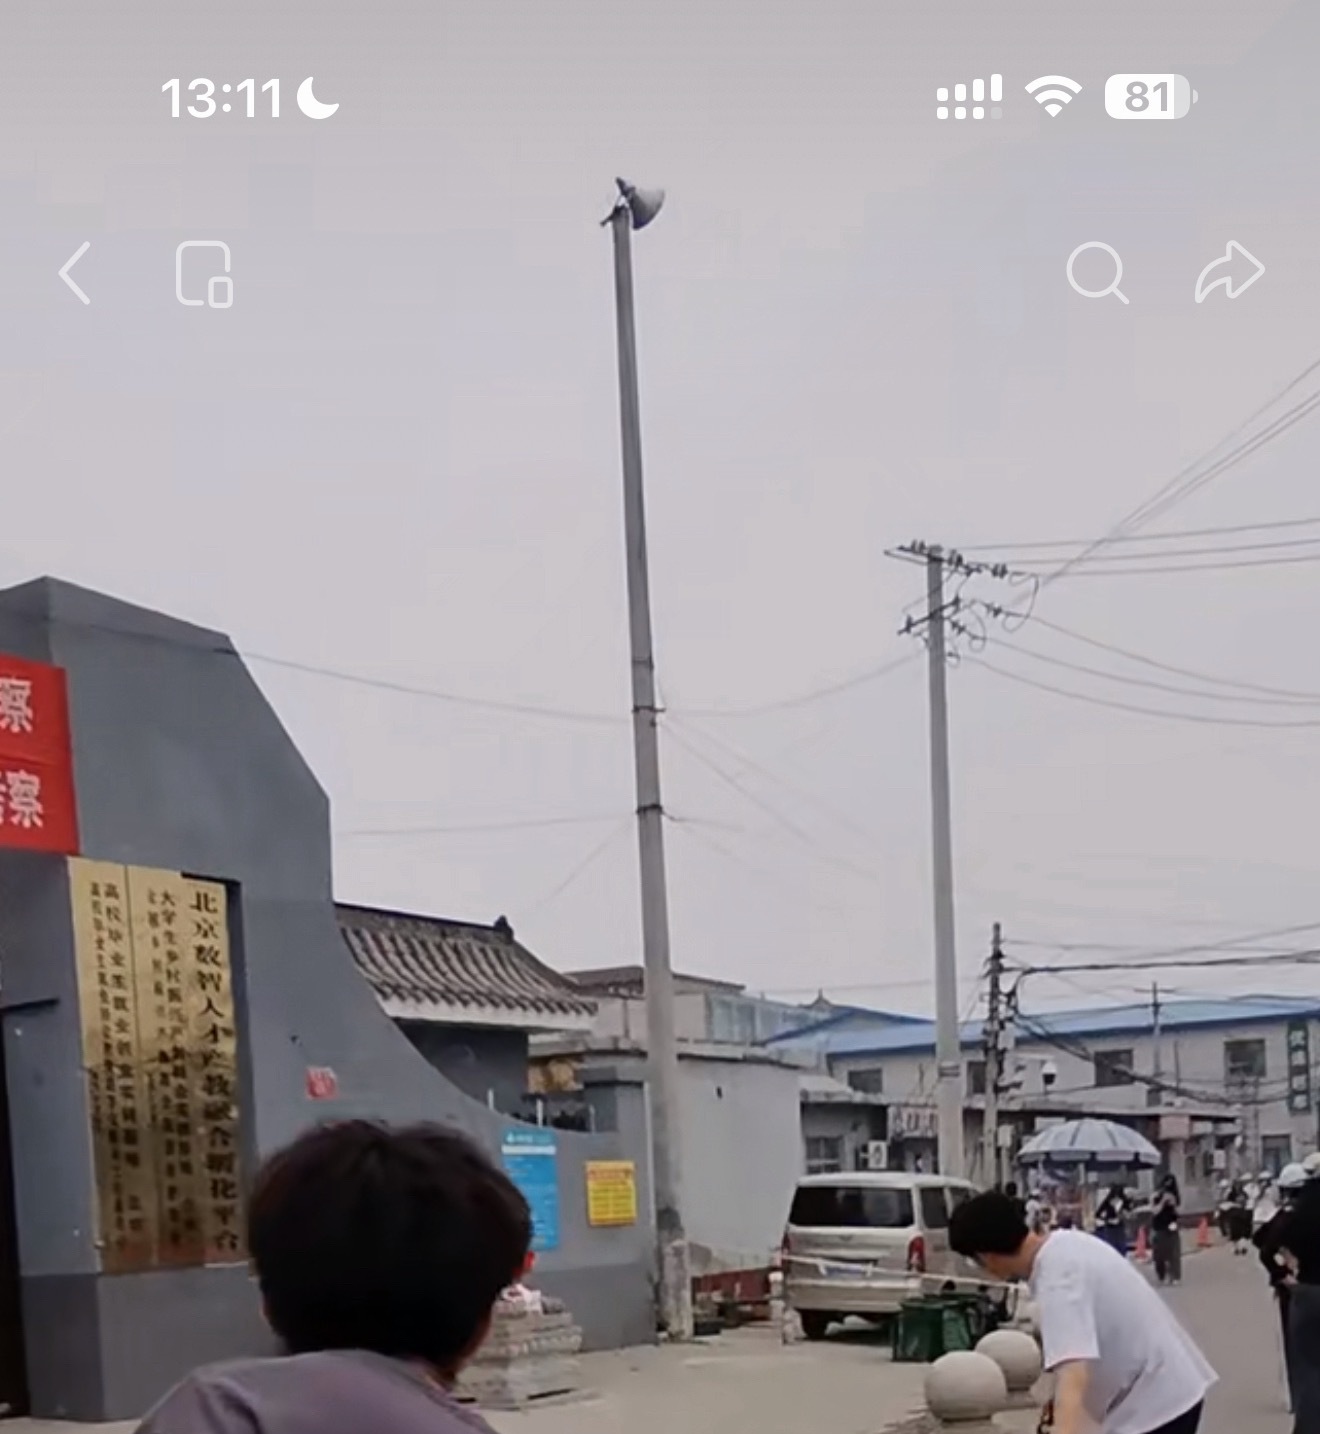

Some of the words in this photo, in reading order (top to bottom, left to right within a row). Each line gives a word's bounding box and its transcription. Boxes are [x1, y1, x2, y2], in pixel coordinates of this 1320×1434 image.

[189, 890, 238, 1250] 北京数智人才产教融合孵化平台
